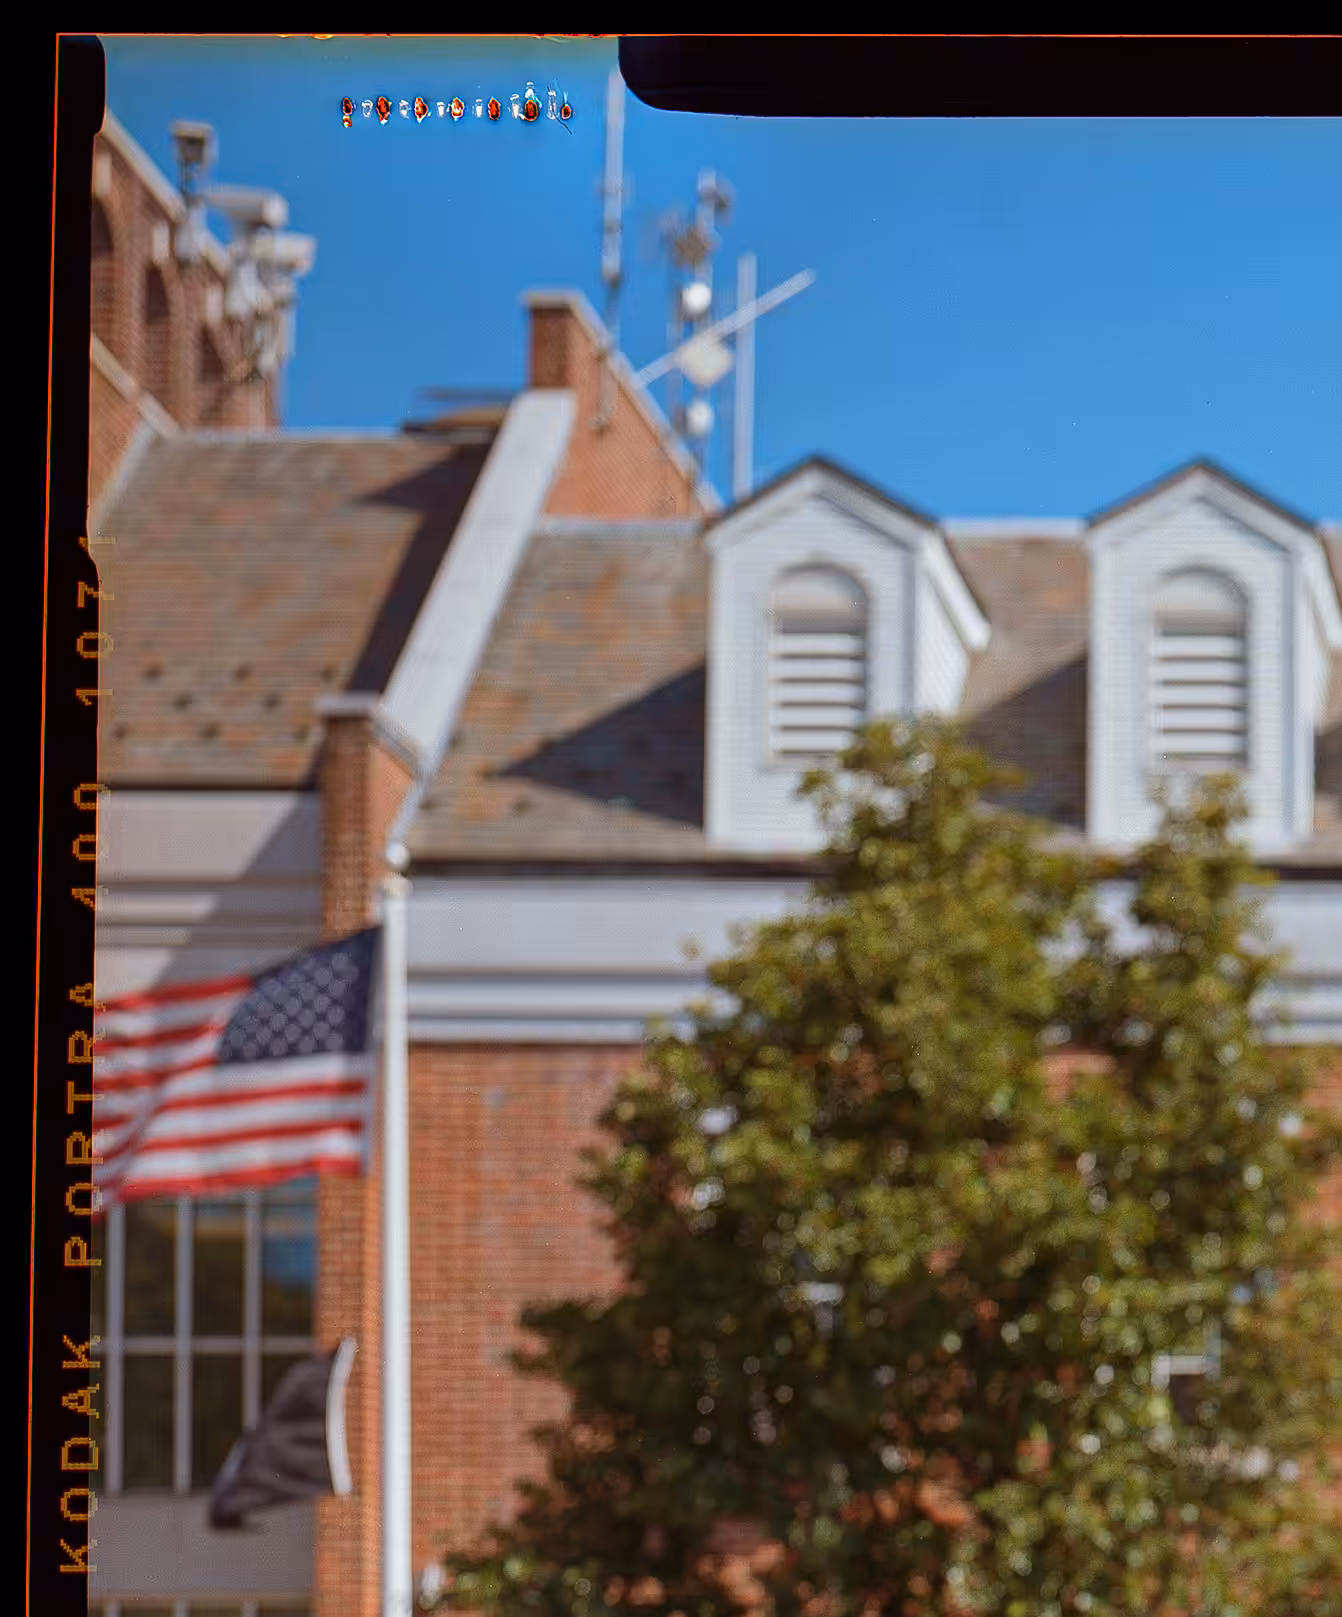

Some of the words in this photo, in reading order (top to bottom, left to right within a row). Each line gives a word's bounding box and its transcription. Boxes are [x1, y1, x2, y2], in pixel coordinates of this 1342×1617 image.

[71, 783, 111, 911] 400
[63, 982, 106, 1267] PORTRA
[60, 1334, 102, 1572] KODAK
